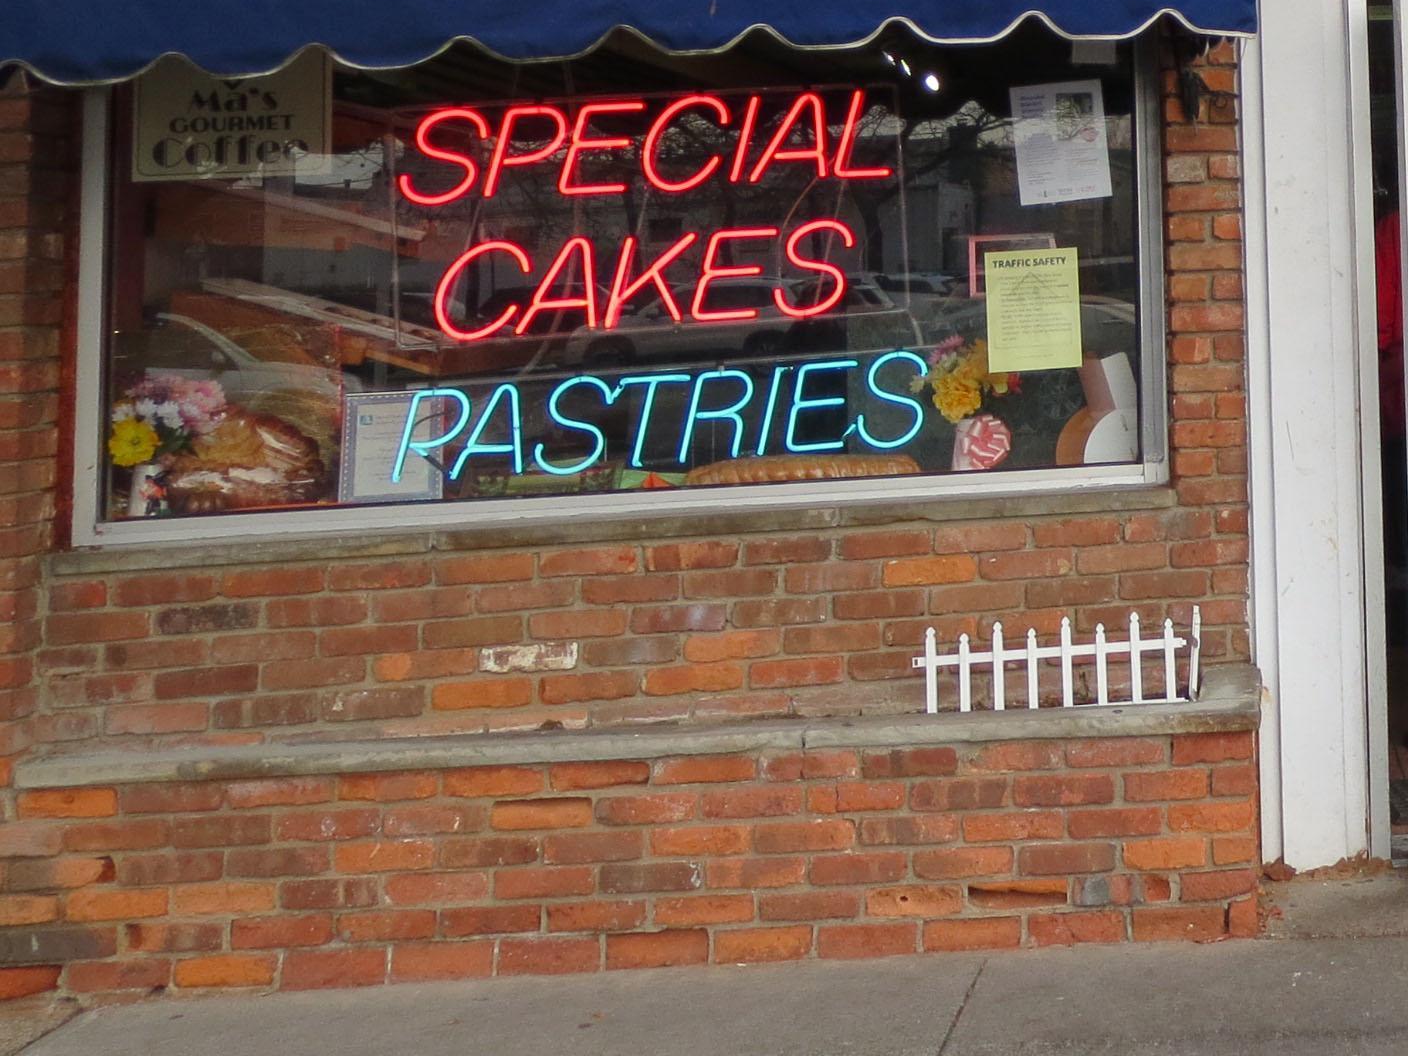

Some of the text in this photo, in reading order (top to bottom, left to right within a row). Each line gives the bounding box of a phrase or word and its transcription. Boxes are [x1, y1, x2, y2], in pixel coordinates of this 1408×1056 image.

[190, 87, 278, 113] Ma's
[169, 115, 294, 133] GOURMET
[152, 135, 309, 168] Coffee
[399, 89, 892, 206] SPECIAL
[992, 256, 1067, 269] TRAFFIC SAFETY
[434, 219, 853, 340] CAKES
[392, 351, 929, 483] PASTRIES
